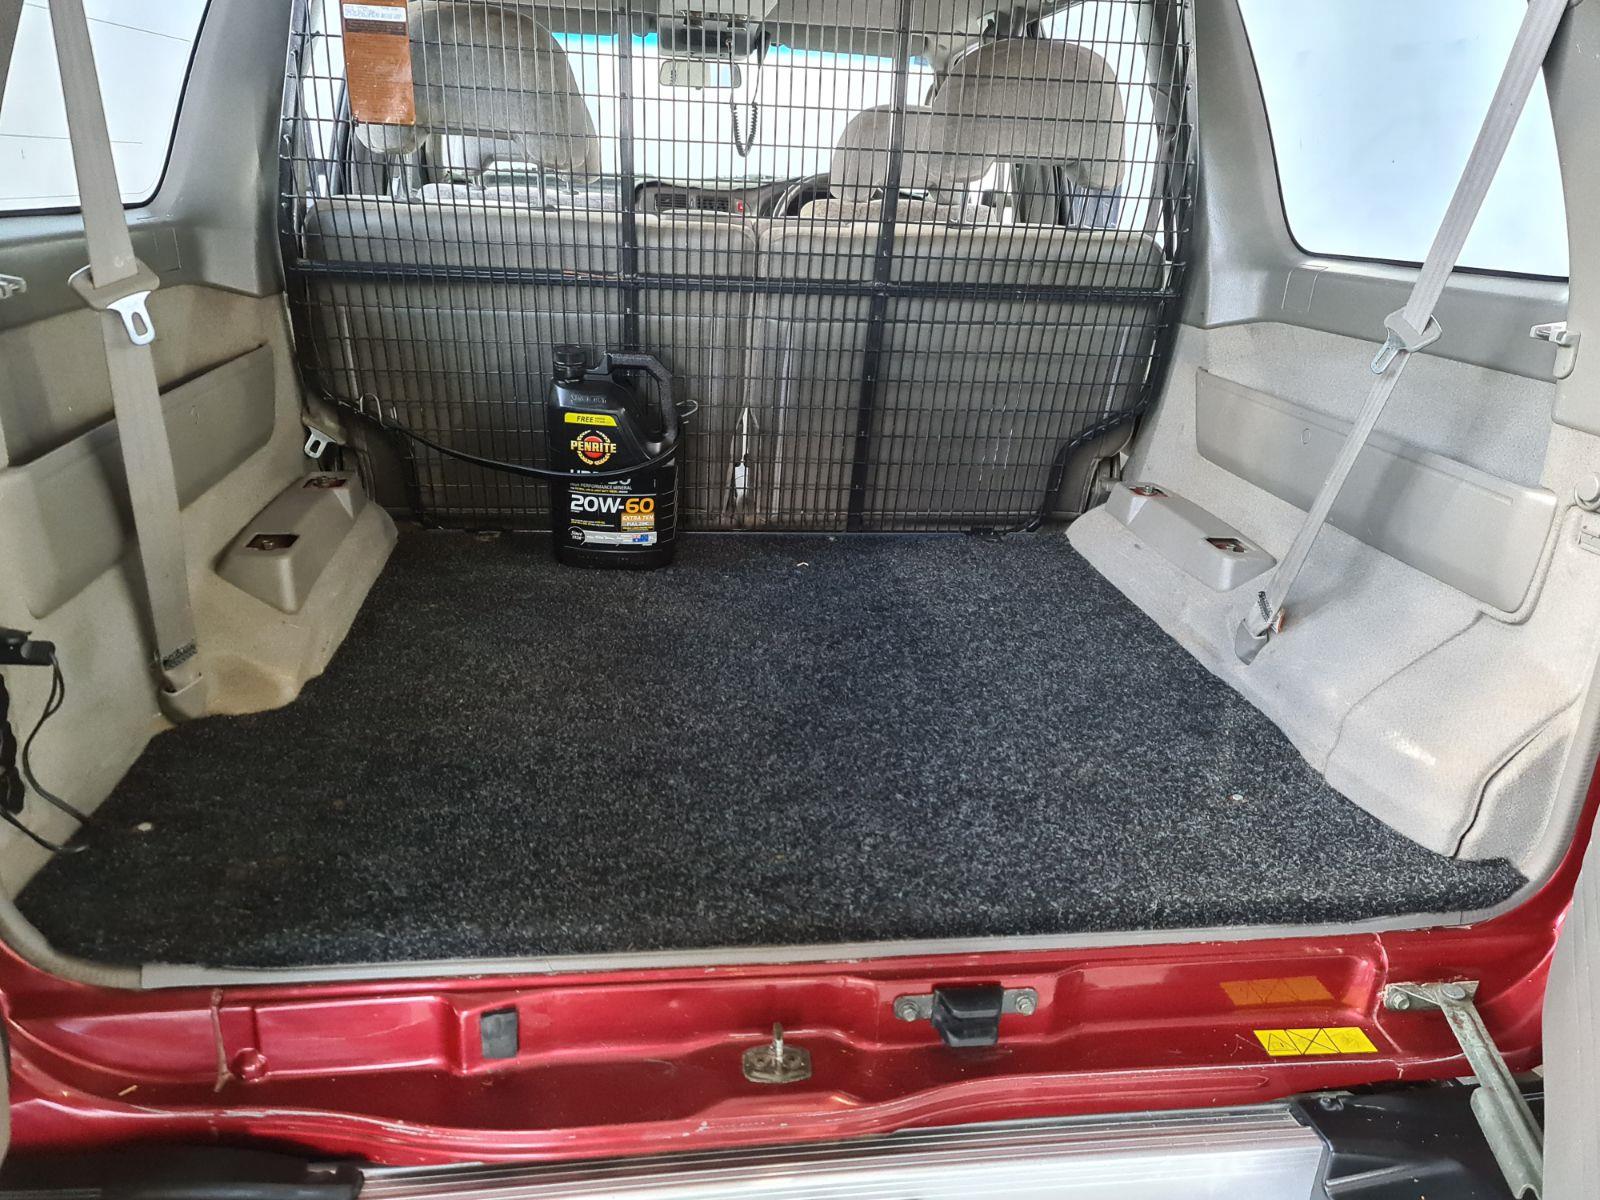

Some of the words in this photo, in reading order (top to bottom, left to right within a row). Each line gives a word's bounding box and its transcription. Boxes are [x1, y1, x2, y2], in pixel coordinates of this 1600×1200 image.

[576, 415, 595, 423] FREE
[570, 440, 617, 453] PENRITE
[570, 494, 655, 514] 20W-60
